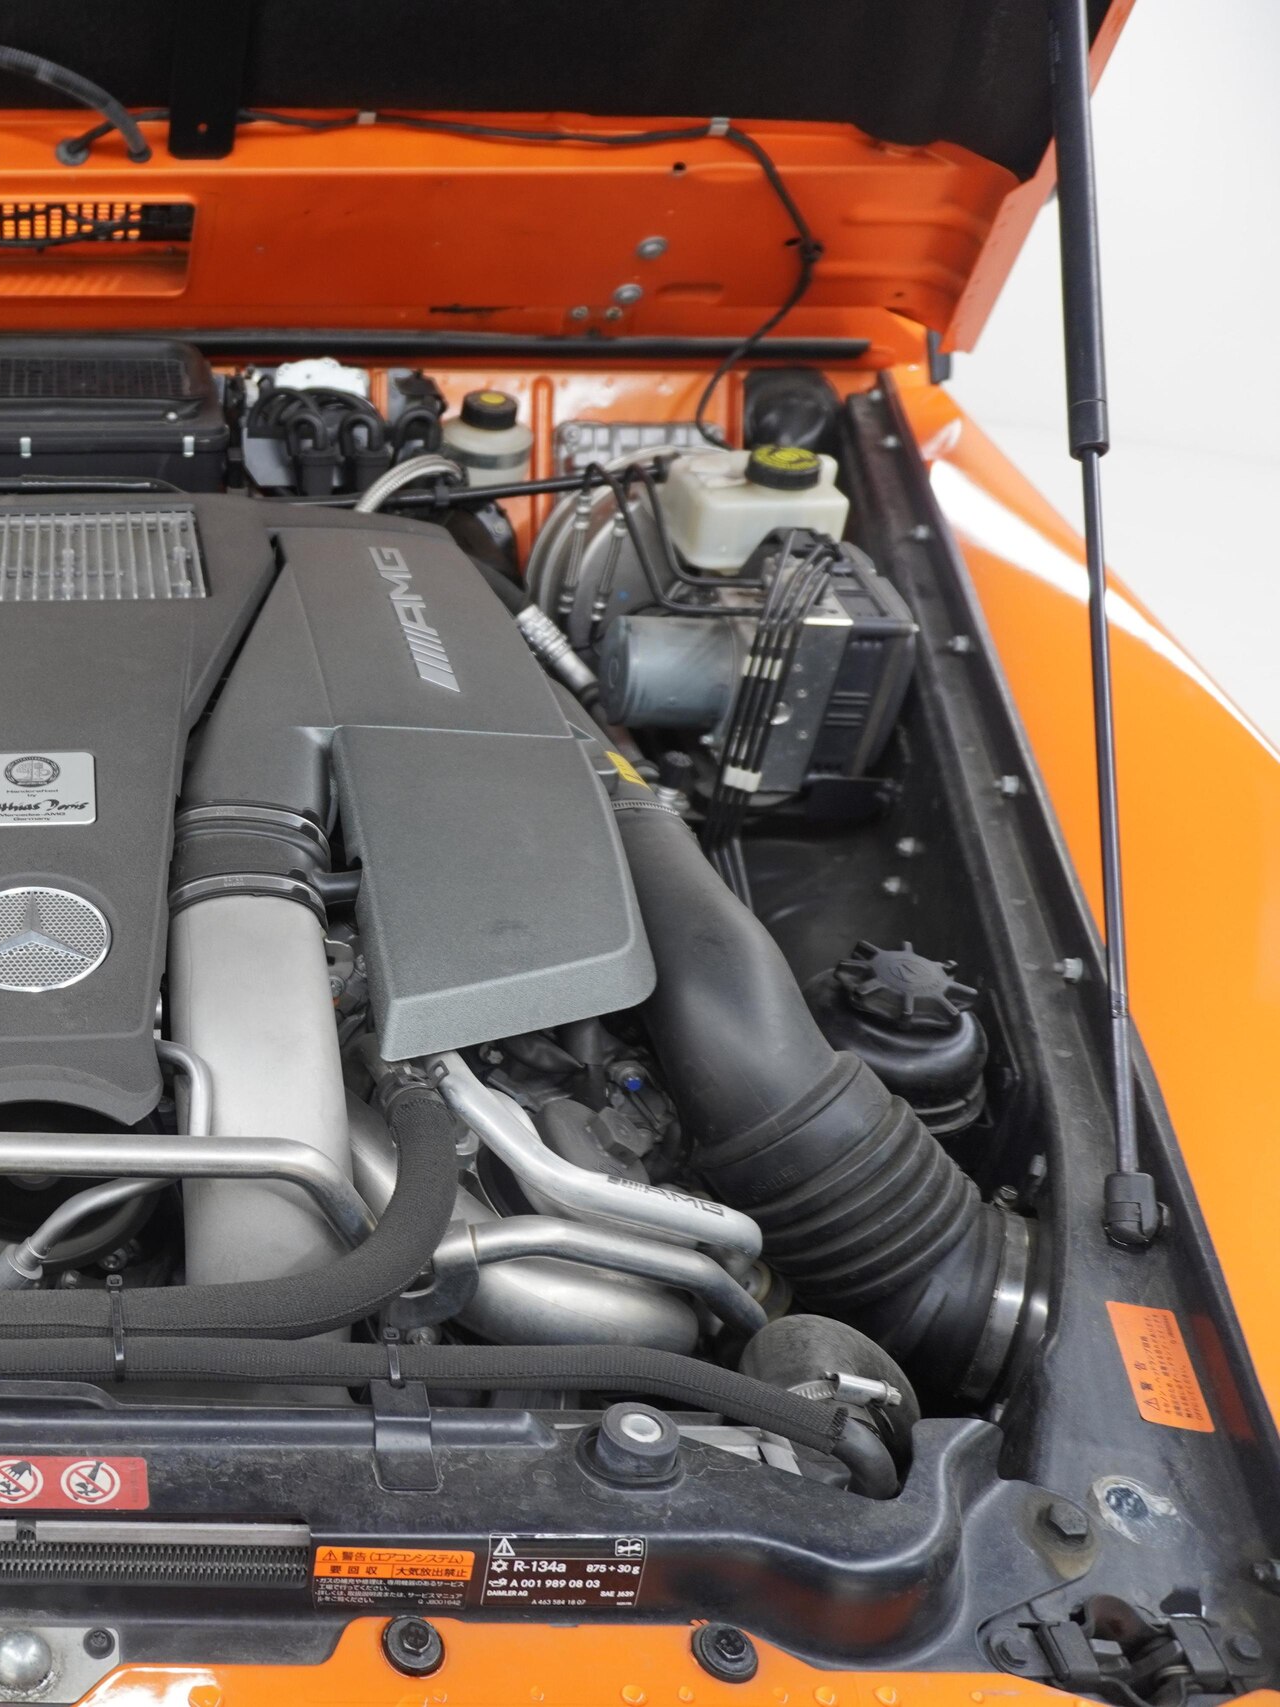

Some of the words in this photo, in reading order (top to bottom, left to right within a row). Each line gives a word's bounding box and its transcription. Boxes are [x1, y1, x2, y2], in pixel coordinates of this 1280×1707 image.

[513, 1560, 567, 1573] R-134a
[586, 1563, 607, 1573] 875
[395, 1567, 468, 1578] 大気放出禁止
[509, 1580, 518, 1588] A
[520, 1580, 542, 1588] 001
[545, 1580, 566, 1588] 989
[568, 1580, 583, 1588] 08
[585, 1580, 600, 1588] 03
